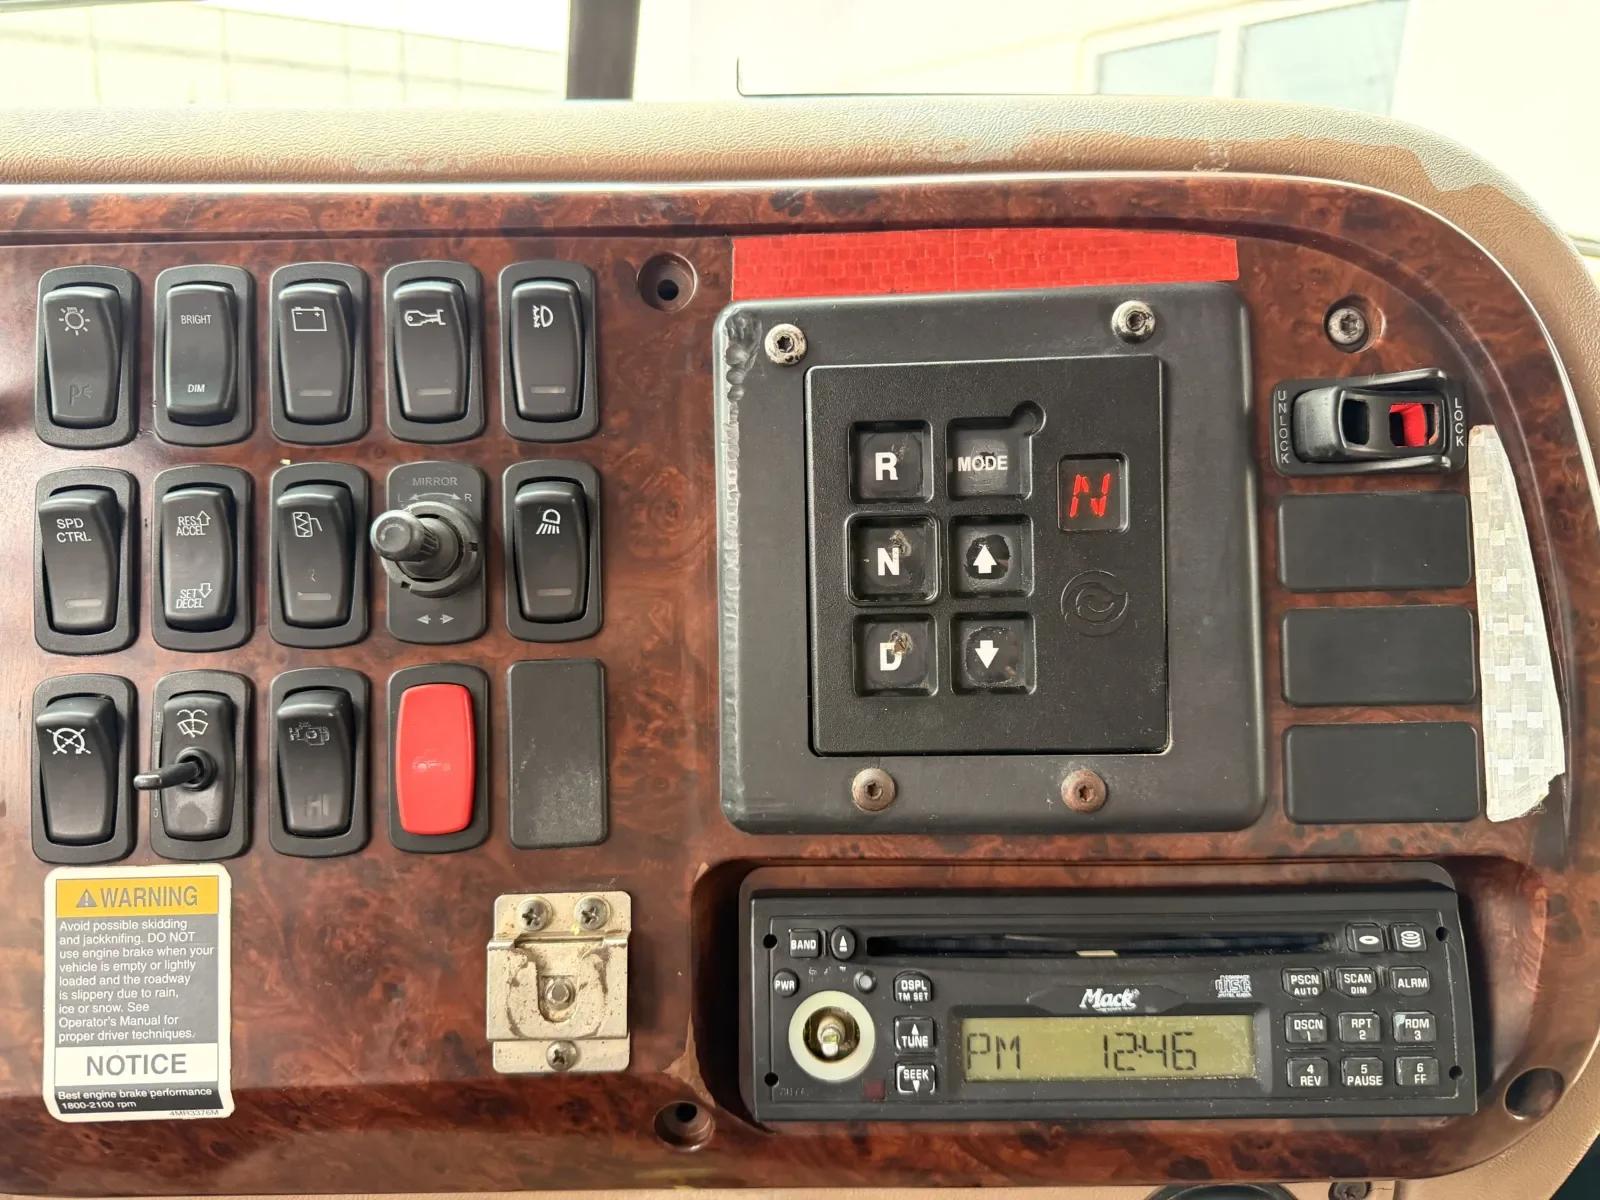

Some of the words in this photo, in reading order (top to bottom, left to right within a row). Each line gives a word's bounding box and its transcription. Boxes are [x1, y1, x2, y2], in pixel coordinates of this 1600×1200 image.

[181, 315, 212, 325] BRIGHT
[187, 384, 205, 393] DIM
[1277, 390, 1290, 464] UNLOCK
[1454, 397, 1464, 447] LOCK
[875, 452, 898, 481] R
[958, 455, 1008, 472] MODE
[412, 476, 458, 486] MIRROR
[464, 493, 472, 502] R
[1069, 473, 1112, 518] N
[57, 518, 84, 529] SPD
[176, 525, 206, 536] ACCEL
[56, 531, 92, 543] CTRL
[877, 547, 900, 576] N
[180, 589, 199, 599] SET
[176, 598, 204, 608] DECEL
[100, 885, 198, 908] WARNING
[59, 921, 90, 931] Avoid
[93, 920, 139, 932] possible
[142, 919, 188, 932] skidding
[59, 935, 80, 945] and
[83, 933, 144, 946] jackknifing.
[148, 933, 166, 942] DO
[169, 932, 196, 942] NOT
[791, 939, 817, 950] BAND
[59, 950, 79, 959] use
[83, 948, 120, 961] engine
[122, 947, 154, 957] brake
[157, 946, 187, 956] when
[189, 947, 214, 958] your
[59, 962, 97, 973] vehicle
[100, 961, 110, 972] is
[113, 961, 147, 973] empty
[150, 962, 160, 970] or
[164, 959, 196, 972] lightly
[59, 975, 96, 986] loaded
[99, 974, 120, 985] and
[123, 974, 140, 984] the
[144, 973, 191, 985] roadway
[1290, 974, 1319, 985] PSCN
[1344, 973, 1372, 984] SCAN
[1398, 978, 1428, 988] ALRM
[774, 980, 795, 991] PWR
[901, 979, 927, 991] DSPL
[1350, 986, 1367, 994] DIM
[59, 990, 68, 1000] is
[71, 989, 114, 1001] slippery
[117, 988, 138, 999] due
[141, 989, 151, 998] to
[898, 992, 912, 1001] TM
[913, 992, 929, 1001] SET
[1294, 987, 1319, 996] AUTO
[1079, 988, 1136, 1009] Mack
[59, 1003, 74, 1014] ice
[77, 1005, 89, 1013] or
[92, 1004, 124, 1013] snow.
[127, 1002, 150, 1012] See
[59, 1016, 117, 1029] Operator's
[119, 1015, 161, 1027] Manual
[164, 1015, 179, 1025] for
[1294, 1019, 1323, 1031] DSCN
[1351, 1018, 1372, 1029] RPT
[1405, 1018, 1430, 1029] RDM
[59, 1031, 95, 1043] proper
[98, 1030, 128, 1040] driver
[131, 1029, 196, 1041] techniques.
[1306, 1031, 1312, 1041] 1
[1359, 1030, 1366, 1040] 2
[1414, 1030, 1422, 1040] 3
[901, 1035, 929, 1047] TUNE
[967, 1033, 1021, 1070] PM
[1103, 1032, 1196, 1071] 12:46
[86, 1053, 187, 1076] NOTICE
[1306, 1064, 1314, 1074] 4
[1361, 1064, 1368, 1074] 5
[1417, 1063, 1424, 1073] 6
[903, 1069, 929, 1081] SEEK
[1300, 1075, 1322, 1086] REV
[1347, 1075, 1383, 1086] PAUSE
[1414, 1074, 1427, 1084] FF
[58, 1090, 80, 1100] Best
[83, 1090, 117, 1101] engine
[119, 1088, 148, 1098] brake
[150, 1087, 213, 1100] performance
[62, 1101, 115, 1110] 1800-2100
[117, 1100, 137, 1110] rpm
